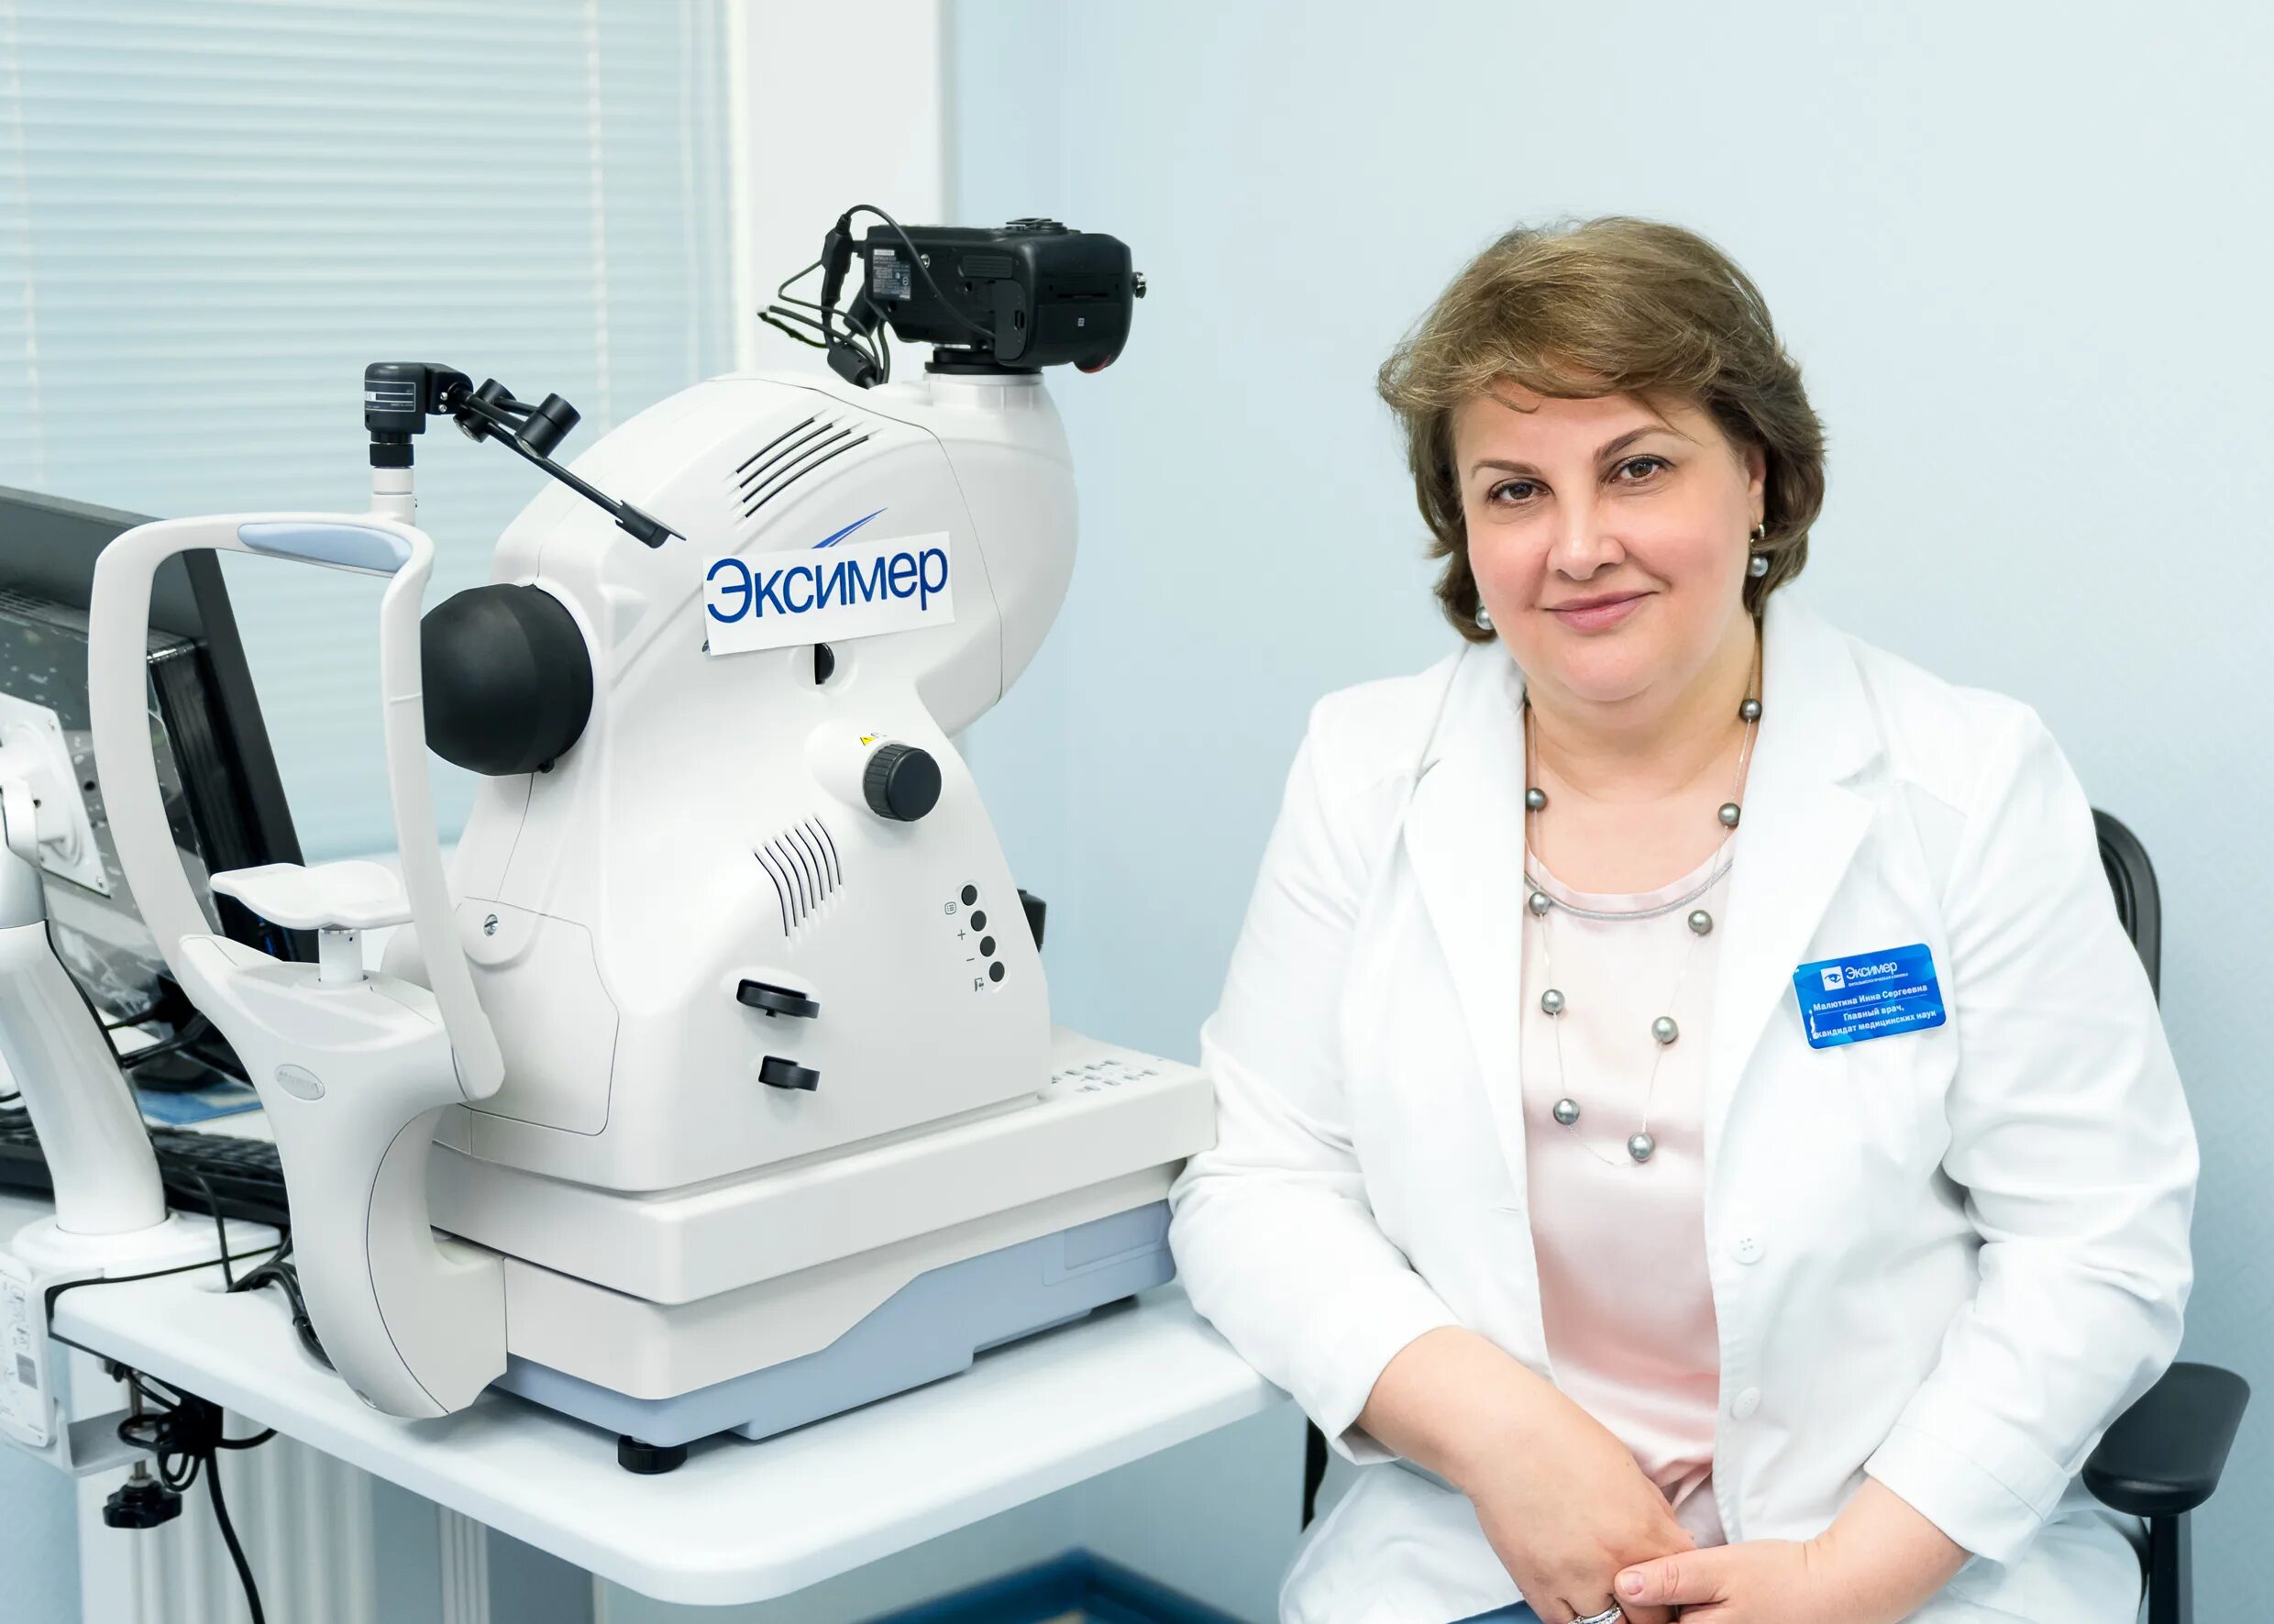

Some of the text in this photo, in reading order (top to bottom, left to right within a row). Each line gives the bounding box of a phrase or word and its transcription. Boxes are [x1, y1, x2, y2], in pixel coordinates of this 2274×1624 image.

[706, 547, 948, 624] Эксимер
[1845, 961, 1898, 979] Эксимер
[1813, 984, 1927, 1011] Малютина Инна Сергеевна
[1816, 1010, 1937, 1038] кандидат медицинских наук
[1843, 1007, 1880, 1021] Главный
